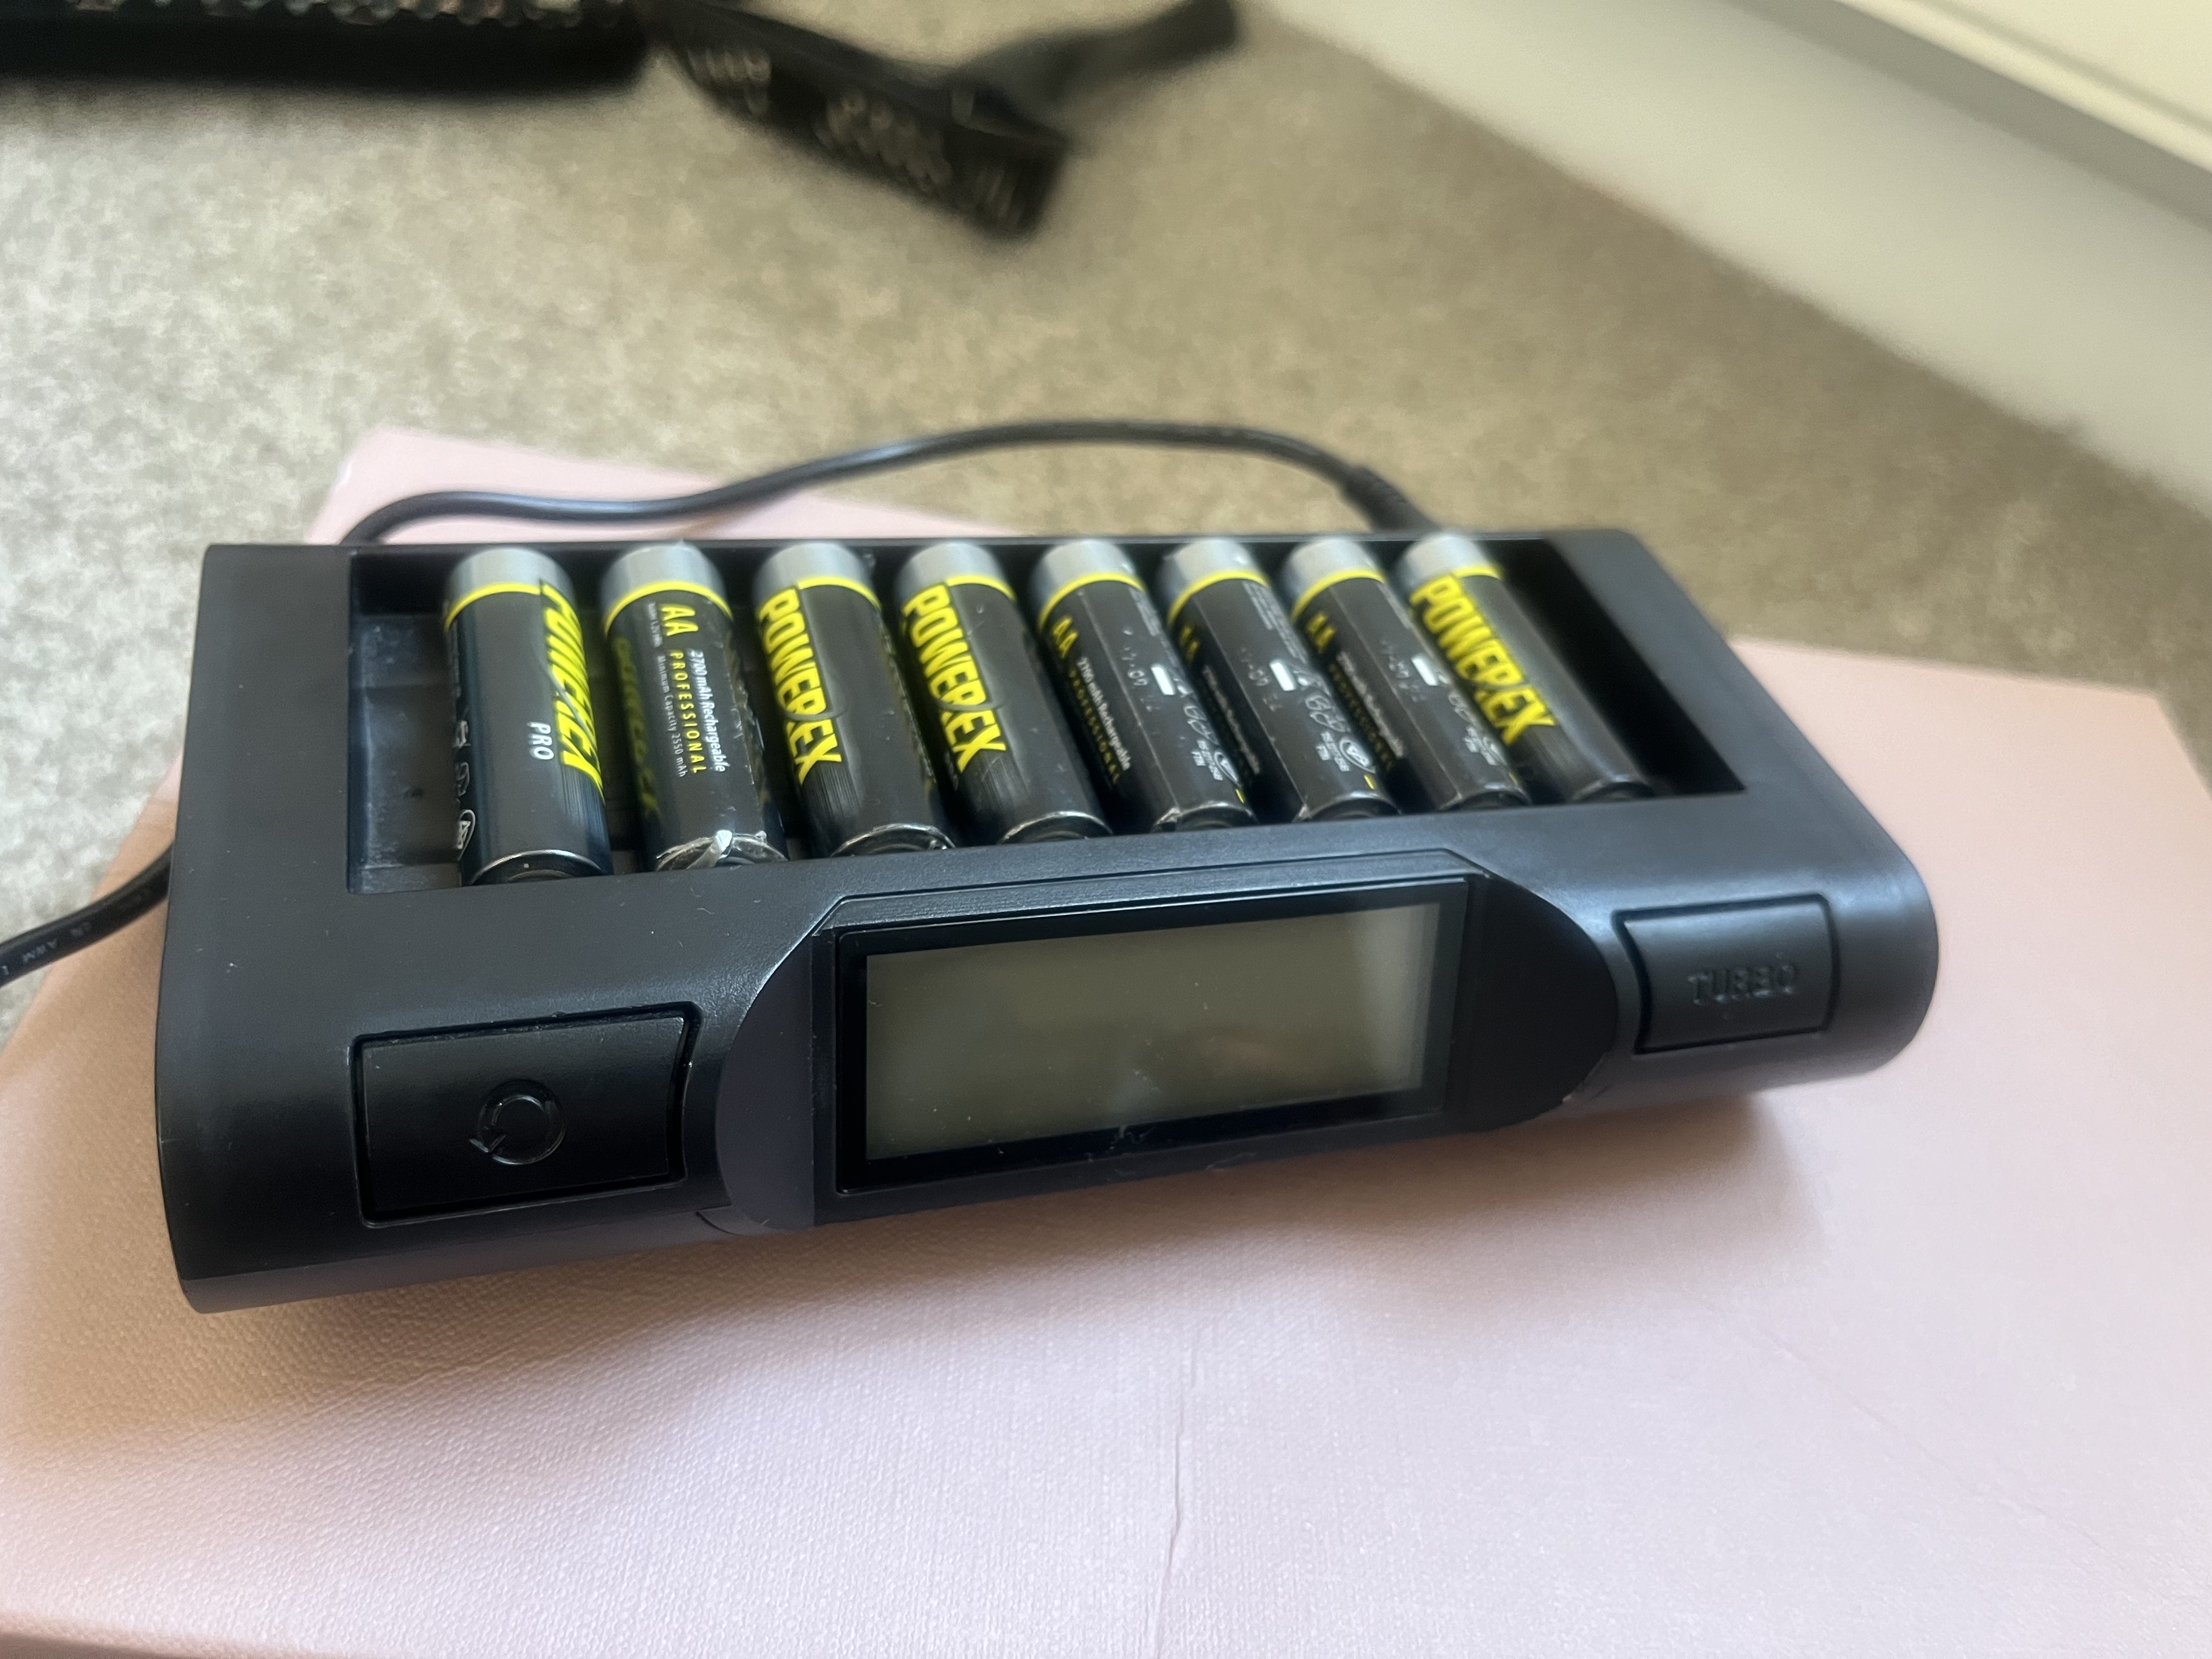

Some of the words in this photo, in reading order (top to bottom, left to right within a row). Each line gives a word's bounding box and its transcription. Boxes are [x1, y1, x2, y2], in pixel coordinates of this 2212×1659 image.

[661, 605, 699, 636] AA
[657, 655, 670, 693] Minimum
[689, 649, 708, 676] 2700
[900, 583, 1007, 774] POWEREX
[1409, 574, 1556, 745] POWEREX
[696, 676, 714, 700] mAh
[757, 588, 842, 786] POWEREX
[664, 694, 678, 732] Capacity
[669, 650, 707, 774] PROFESSIONAL
[528, 721, 555, 760] PRO
[671, 732, 684, 755] 2550
[698, 702, 731, 772] Rechargeable
[676, 757, 689, 777] mAh
